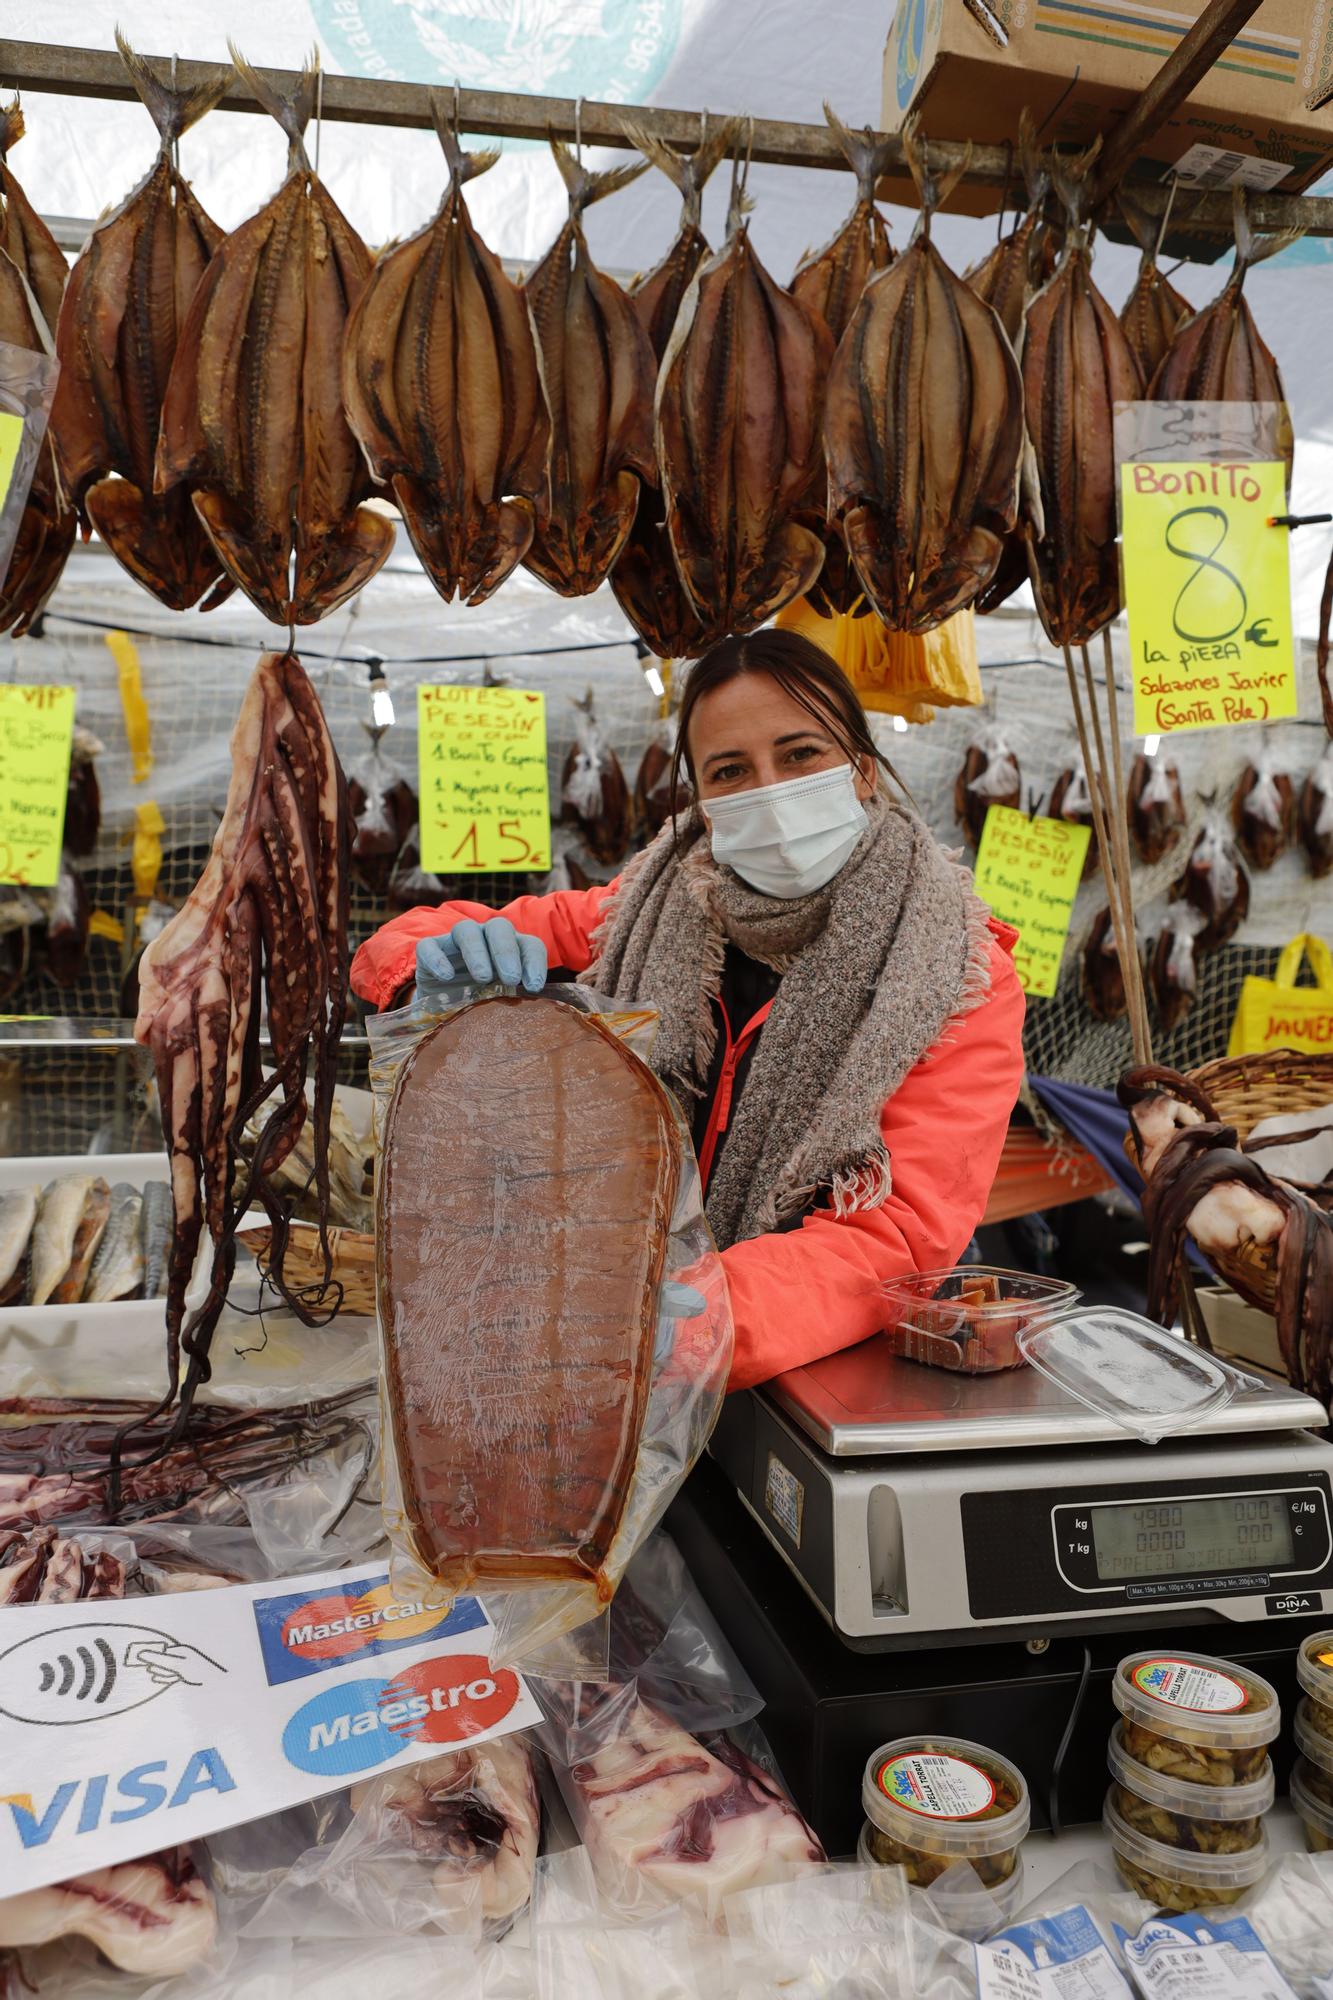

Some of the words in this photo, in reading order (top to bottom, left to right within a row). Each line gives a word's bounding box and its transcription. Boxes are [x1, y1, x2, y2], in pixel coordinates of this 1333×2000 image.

[1139, 673, 1220, 696] Salazones
[1227, 671, 1288, 690] Javier
[22, 685, 65, 709] VIP
[435, 686, 514, 708] LOTES
[996, 812, 1070, 842] LOTES
[1291, 1501, 1316, 1513] €/kg
[1075, 1519, 1088, 1530] kg
[1295, 1525, 1304, 1535] €
[1077, 1544, 1090, 1555] kg
[1276, 1598, 1310, 1610] DINA
[1168, 1683, 1180, 1701] CAPELLA
[1176, 1667, 1188, 1685] TORRAT
[308, 1678, 498, 1752] Maestro
[912, 1760, 929, 1784] TORRAT
[0, 1747, 238, 1849] VISA
[922, 1784, 942, 1812] CAPELLA
